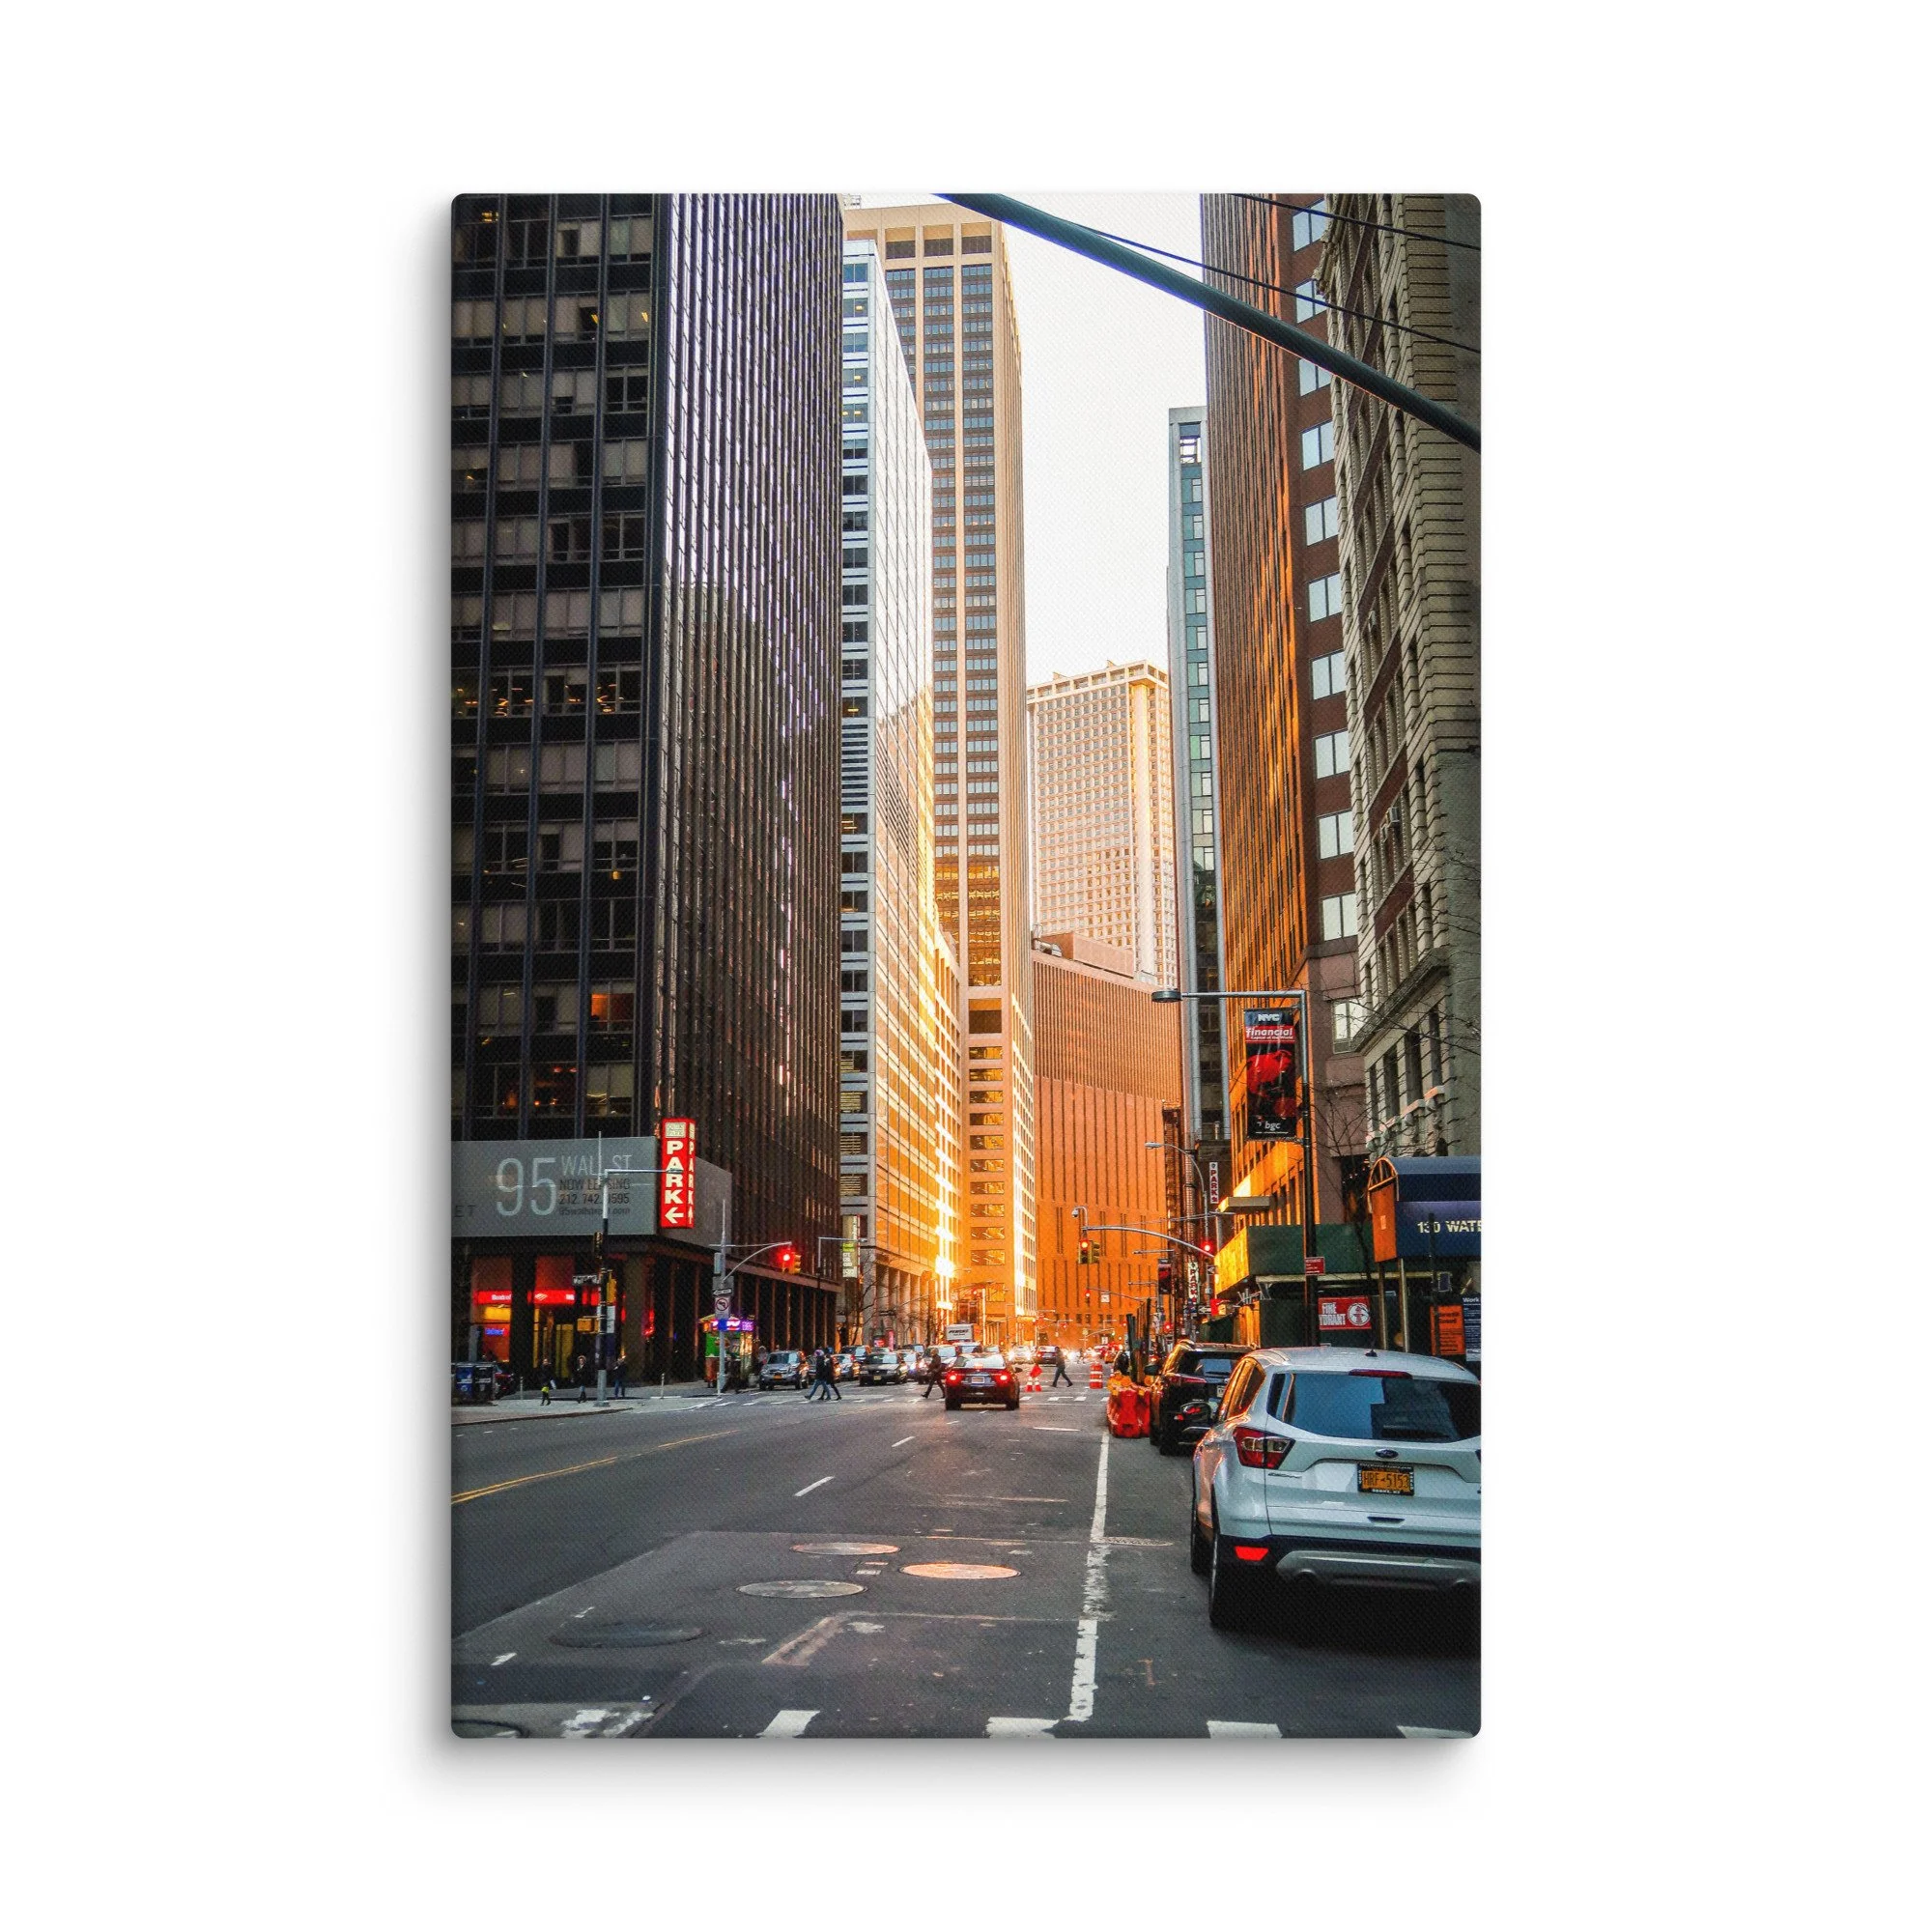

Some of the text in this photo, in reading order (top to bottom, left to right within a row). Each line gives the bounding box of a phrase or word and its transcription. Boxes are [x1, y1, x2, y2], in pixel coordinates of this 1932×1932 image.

[1258, 1013, 1280, 1022] NYC
[1246, 1026, 1293, 1037] financial
[1264, 1121, 1281, 1131] bgc
[665, 1141, 684, 1205] PARK
[497, 1157, 557, 1216] 95
[612, 1154, 633, 1176] ST
[587, 1178, 631, 1191] LESING
[1417, 1221, 1441, 1234] 130
